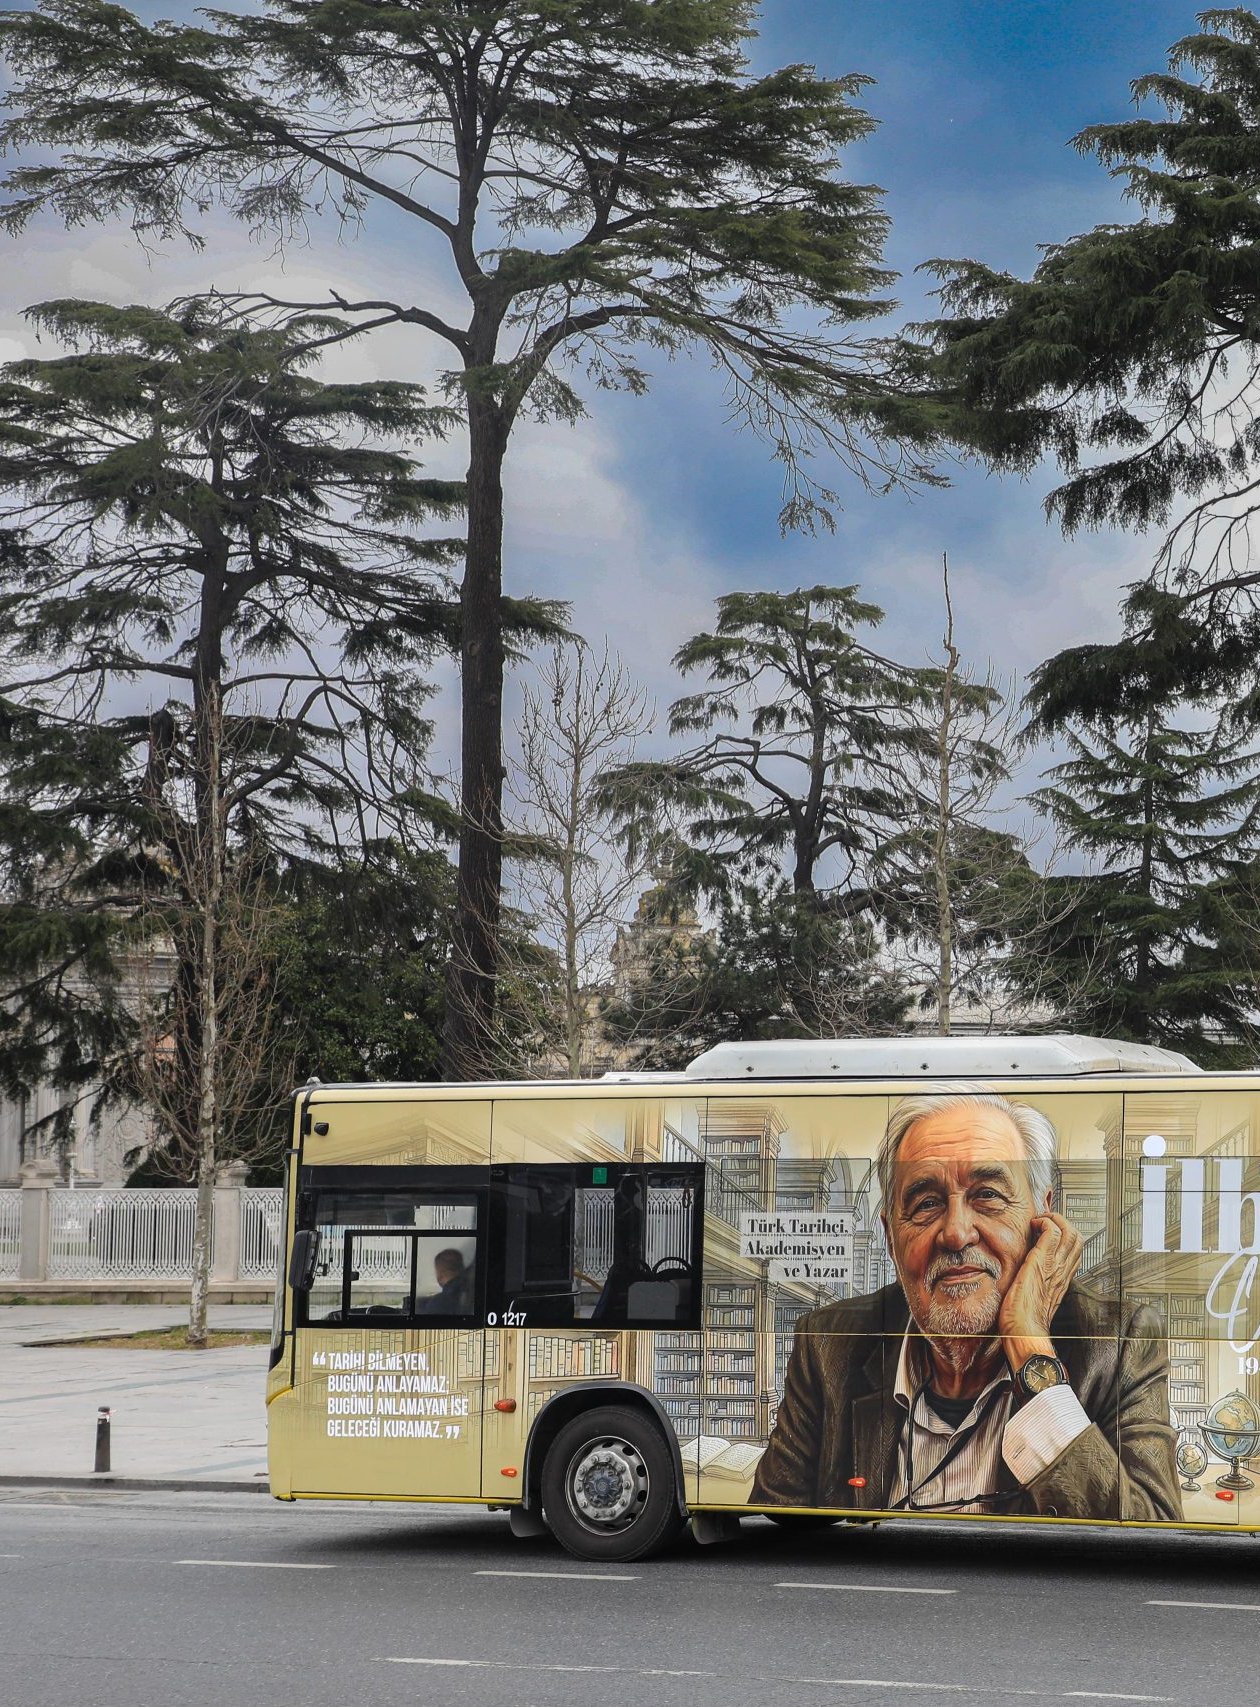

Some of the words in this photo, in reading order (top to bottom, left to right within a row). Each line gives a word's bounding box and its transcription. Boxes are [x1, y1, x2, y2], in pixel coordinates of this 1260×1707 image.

[747, 1219, 786, 1233] Türk
[789, 1219, 849, 1238] Tarihçi,
[745, 1240, 845, 1260] Akademisyen
[784, 1267, 800, 1278] ve
[804, 1263, 848, 1278] Yazar
[502, 1312, 527, 1327] 1217
[368, 1350, 430, 1372] BİLMEYEN,
[327, 1372, 374, 1393] BUGÜNÜ
[327, 1394, 374, 1415] BUGÜNÜ
[376, 1398, 448, 1416] ANLAMAYAN
[450, 1395, 469, 1416] İSE
[327, 1417, 381, 1438] GELECEĞİ
